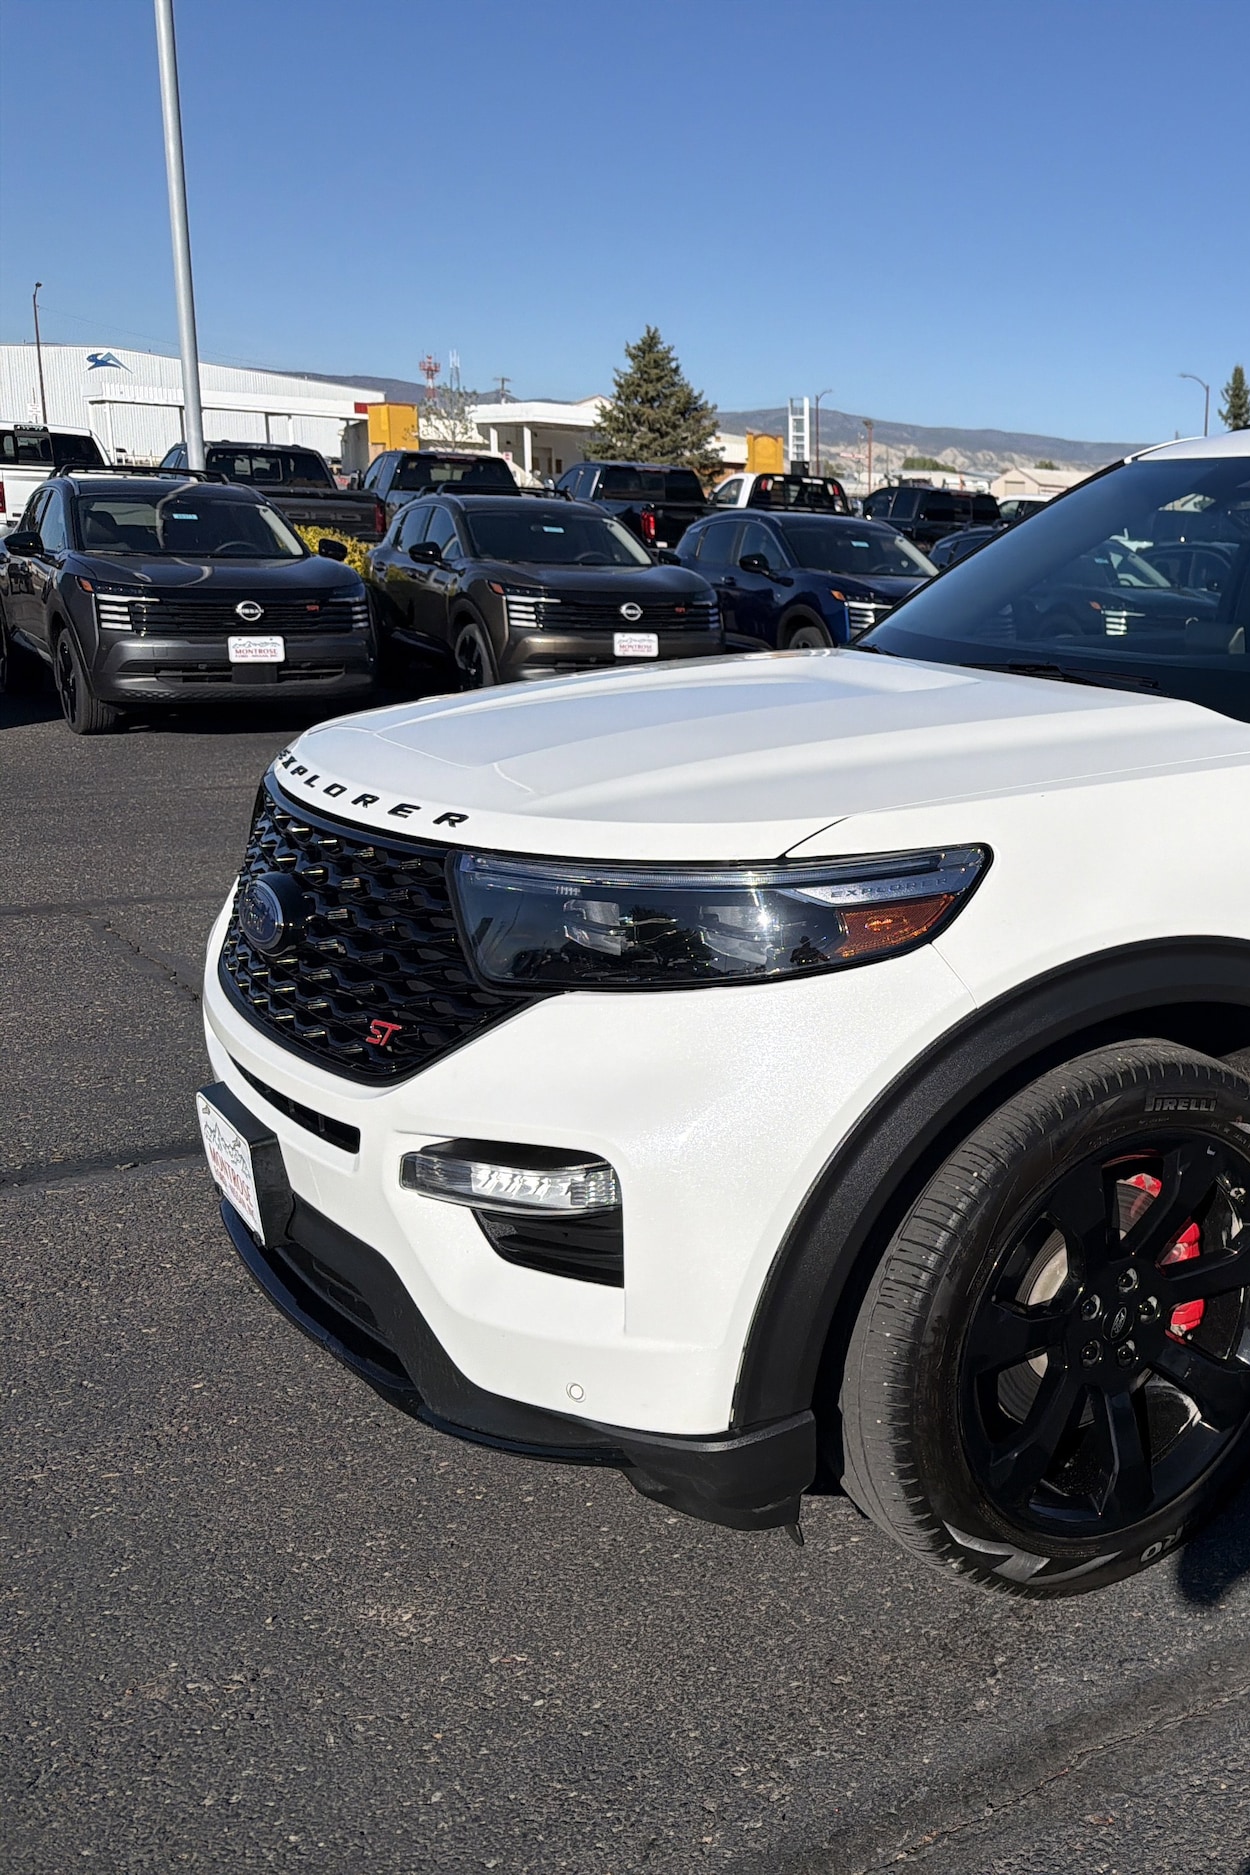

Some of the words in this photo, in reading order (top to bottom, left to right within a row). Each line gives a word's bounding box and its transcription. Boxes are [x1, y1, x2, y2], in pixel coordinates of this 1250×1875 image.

[283, 510, 362, 522] ORD
[831, 876, 948, 899] EXPLORER
[366, 1019, 402, 1046] ST
[1144, 1091, 1218, 1112] PIRELLI
